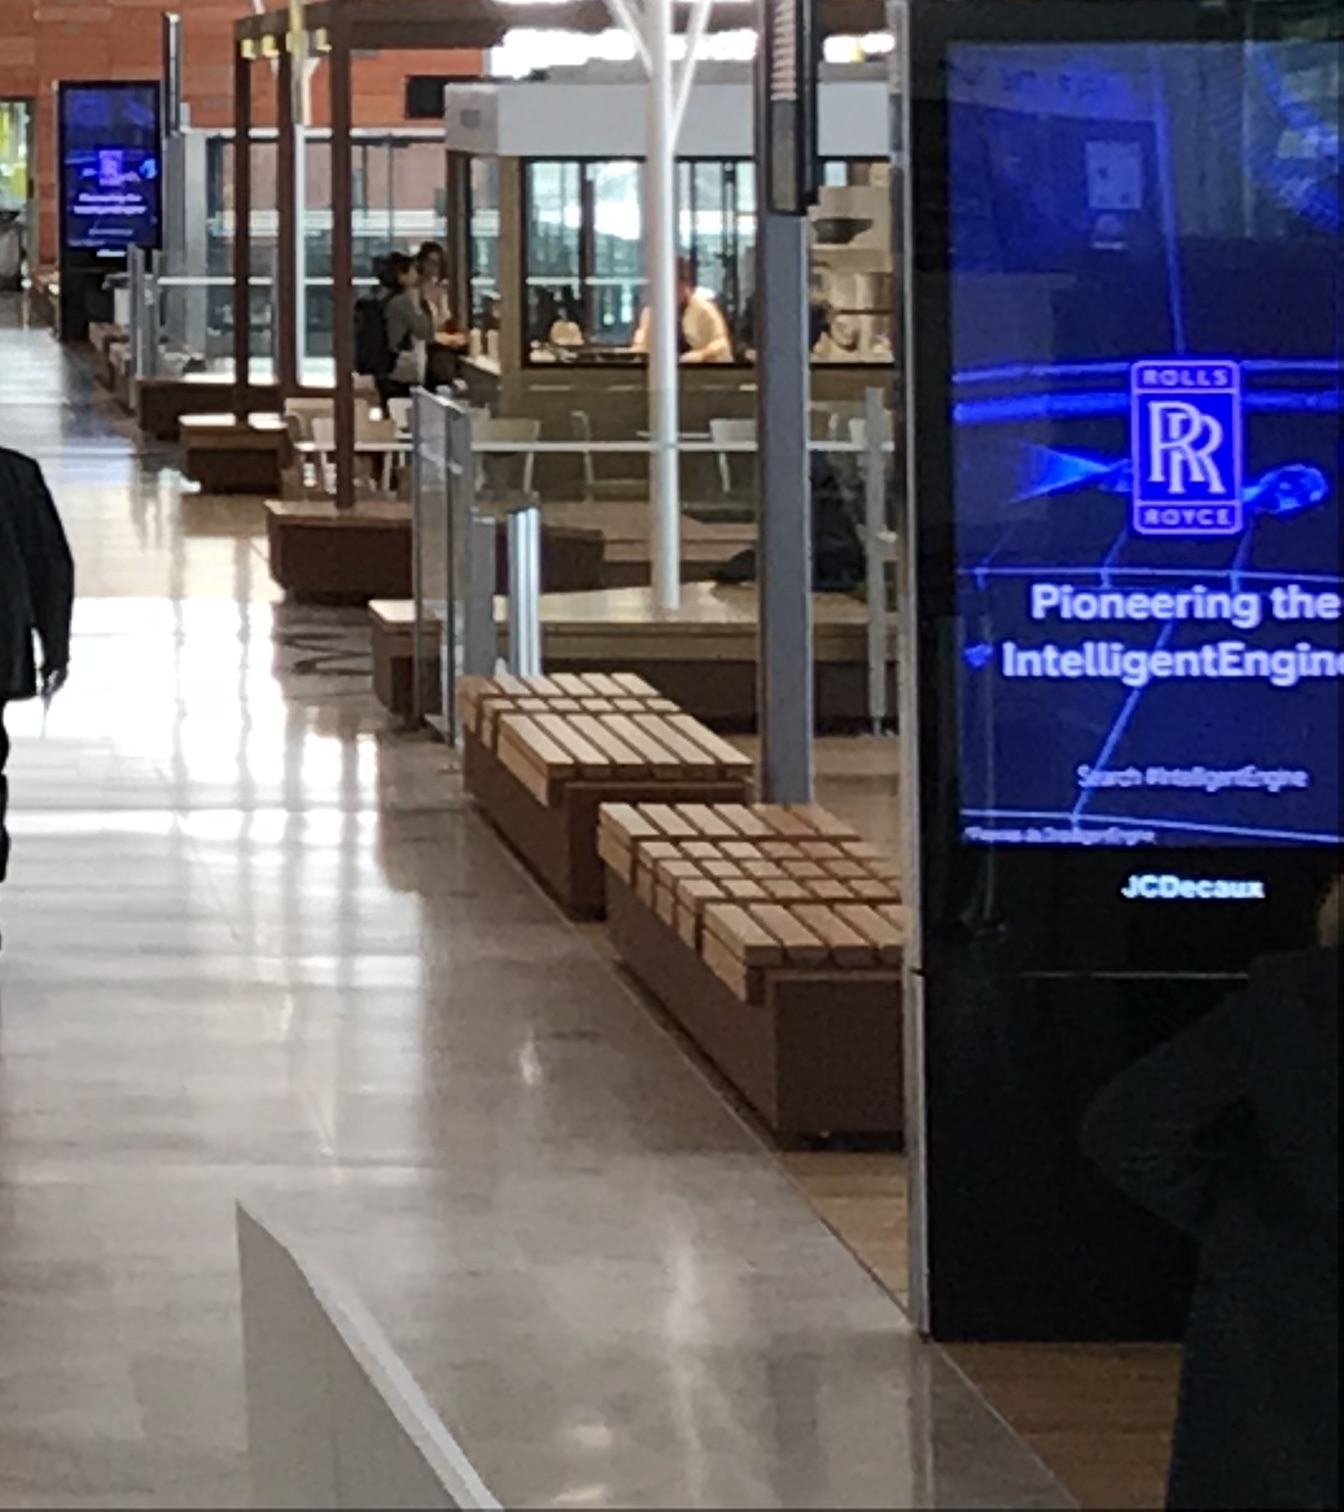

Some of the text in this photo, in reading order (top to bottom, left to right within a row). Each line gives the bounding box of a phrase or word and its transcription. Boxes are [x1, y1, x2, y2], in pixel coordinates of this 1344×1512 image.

[1142, 369, 1229, 387] ROLLS
[1144, 508, 1231, 526] ROYCE
[1031, 583, 1342, 629] Pioneering the
[1120, 874, 1266, 899] JCDecaux
